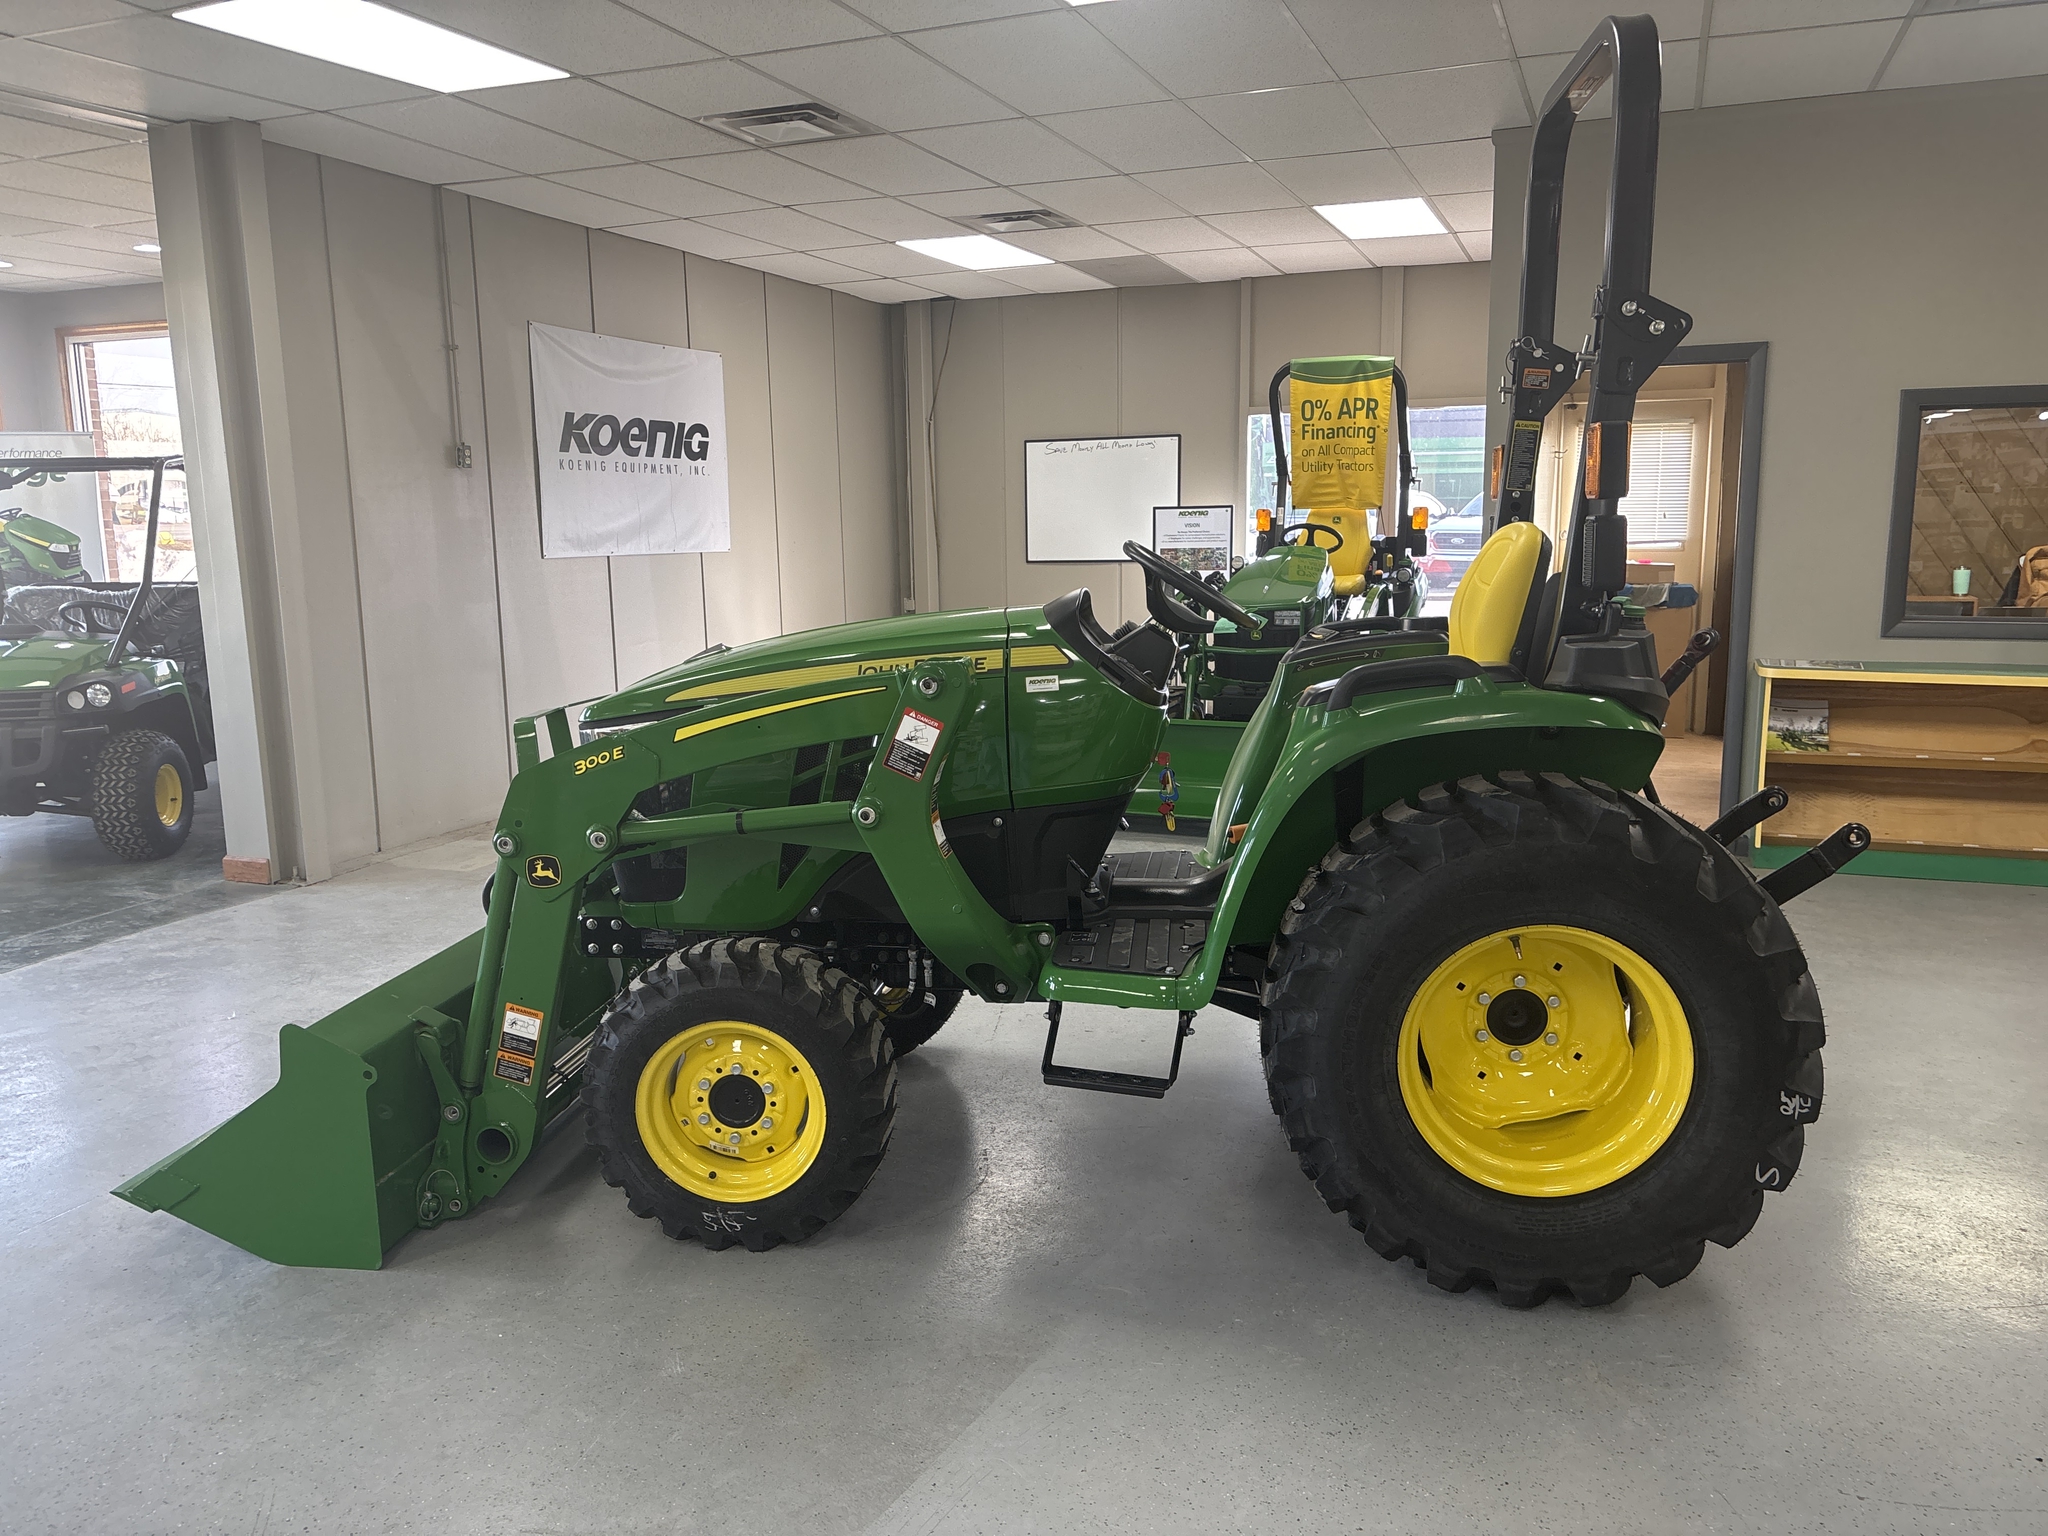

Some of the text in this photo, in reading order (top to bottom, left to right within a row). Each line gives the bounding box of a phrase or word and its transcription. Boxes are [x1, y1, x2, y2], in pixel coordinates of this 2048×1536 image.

[1301, 397, 1379, 422] 0% APR
[1302, 443, 1376, 459] on All Compact
[559, 458, 711, 477] KOENIG EQUIPMENT, INC.
[1301, 459, 1374, 475] Utility Tractors
[916, 714, 939, 728] DANGER
[515, 1006, 539, 1018] WARNING
[507, 1054, 531, 1066] WARNING
